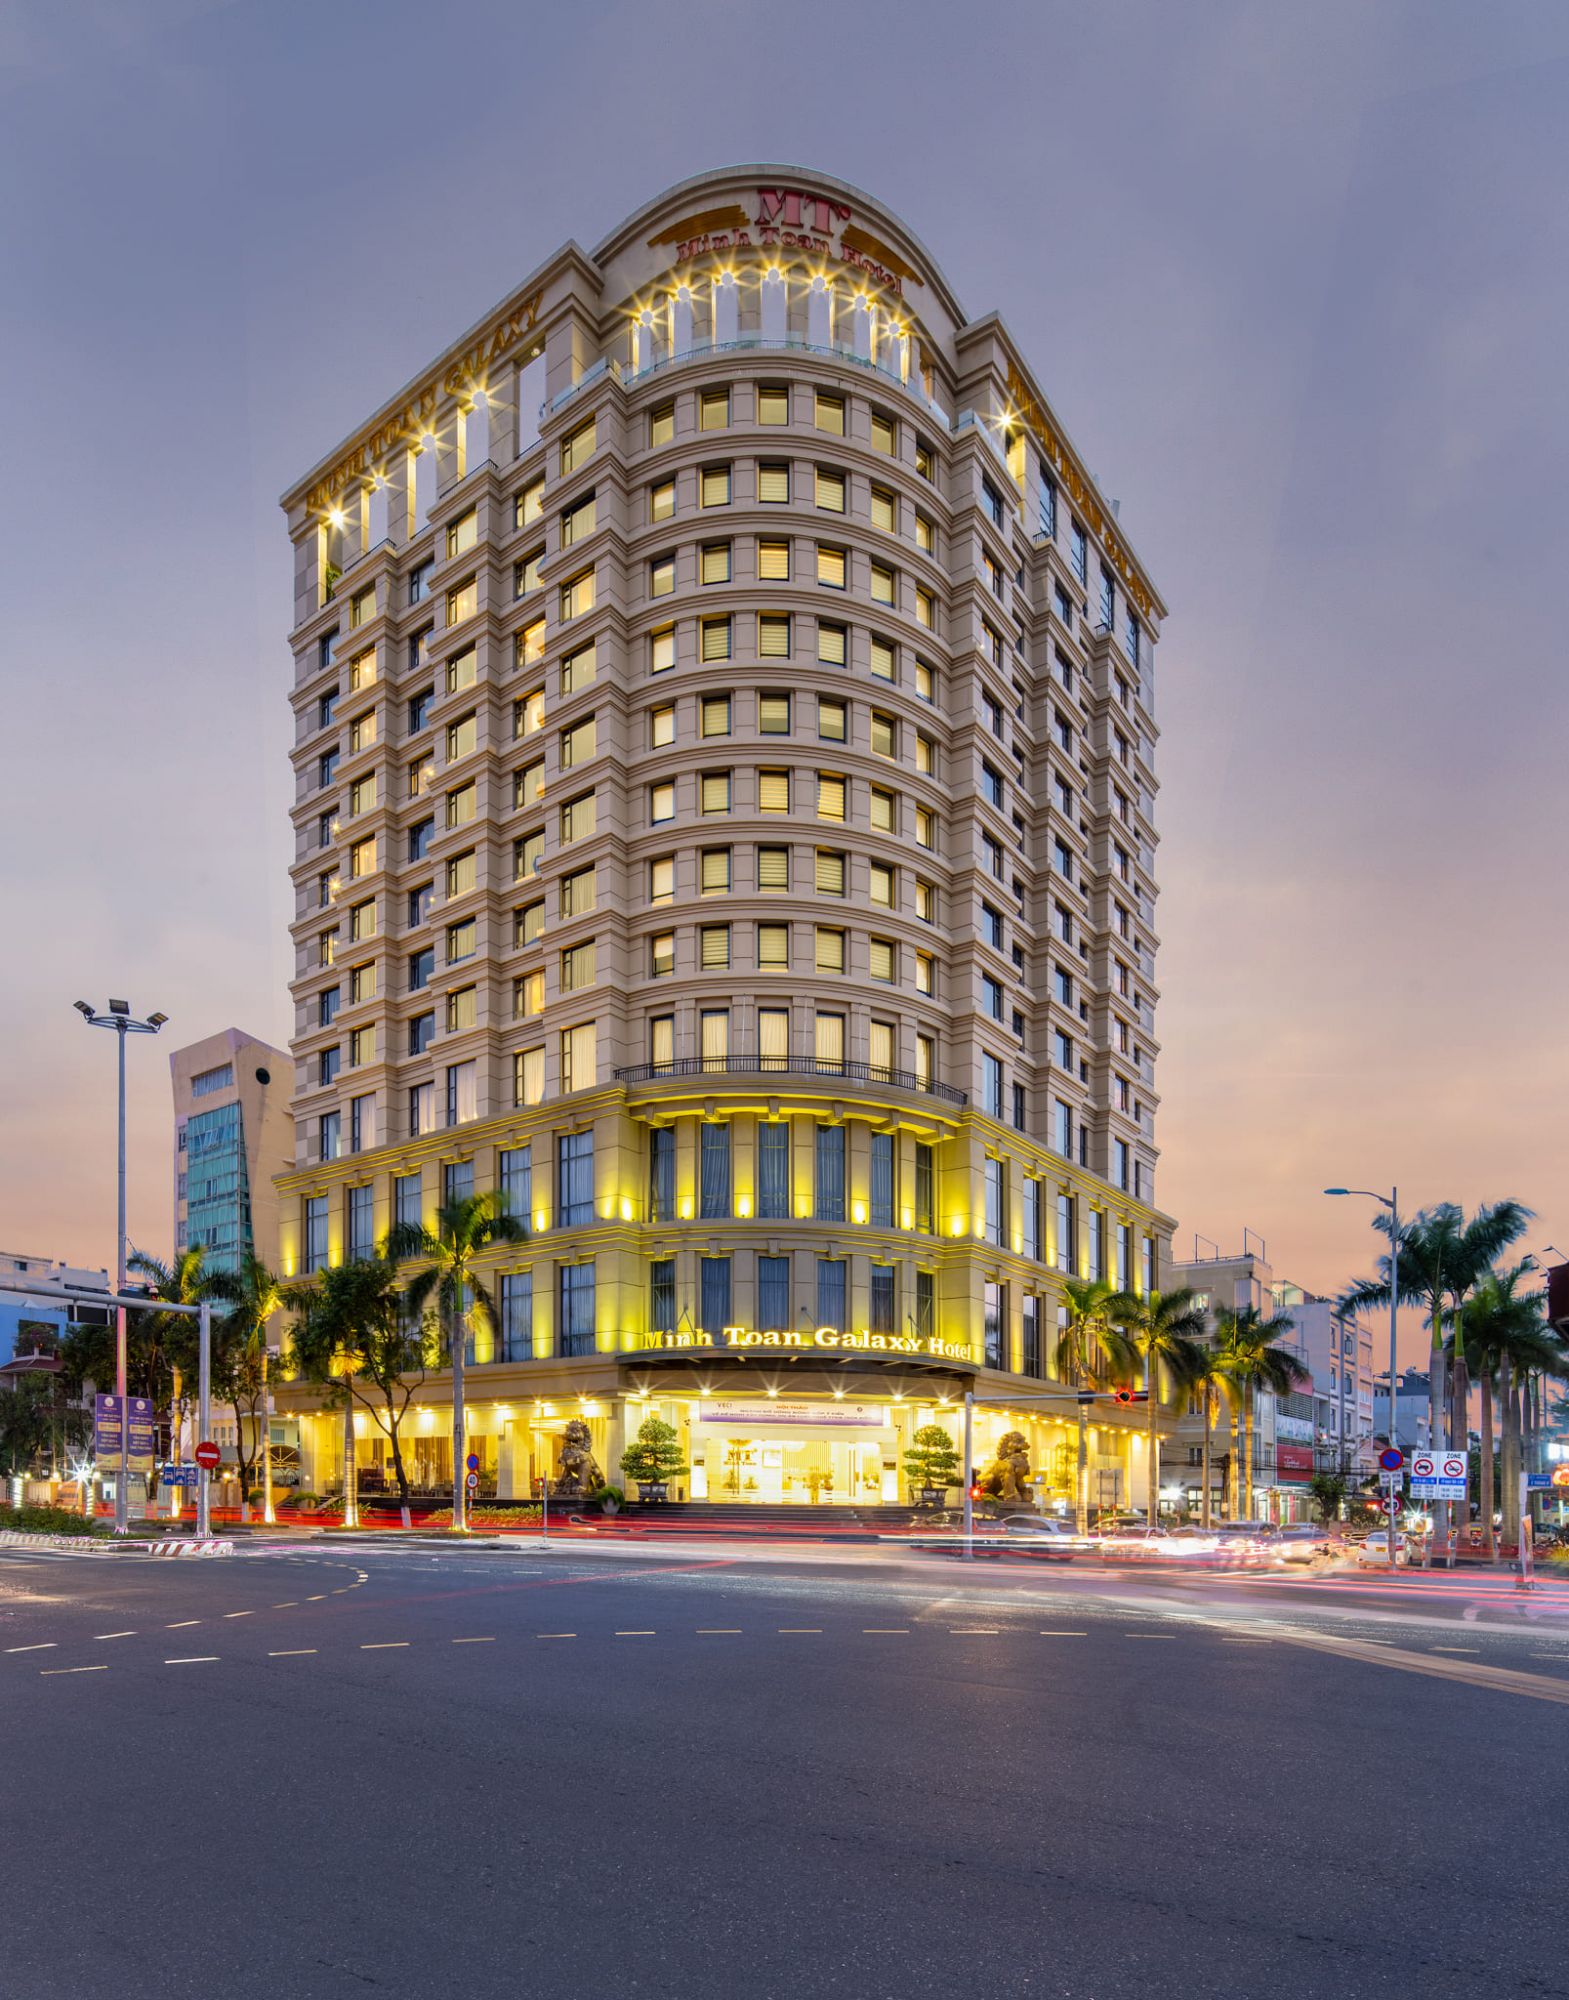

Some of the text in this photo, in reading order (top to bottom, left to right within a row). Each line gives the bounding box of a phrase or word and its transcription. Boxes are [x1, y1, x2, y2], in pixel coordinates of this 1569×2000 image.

[755, 188, 851, 237] MT
[676, 226, 904, 297] Minh Toan Hotel
[444, 289, 545, 396] GALAXY
[643, 1327, 972, 1361] Minh Toan Galaxy Hotel
